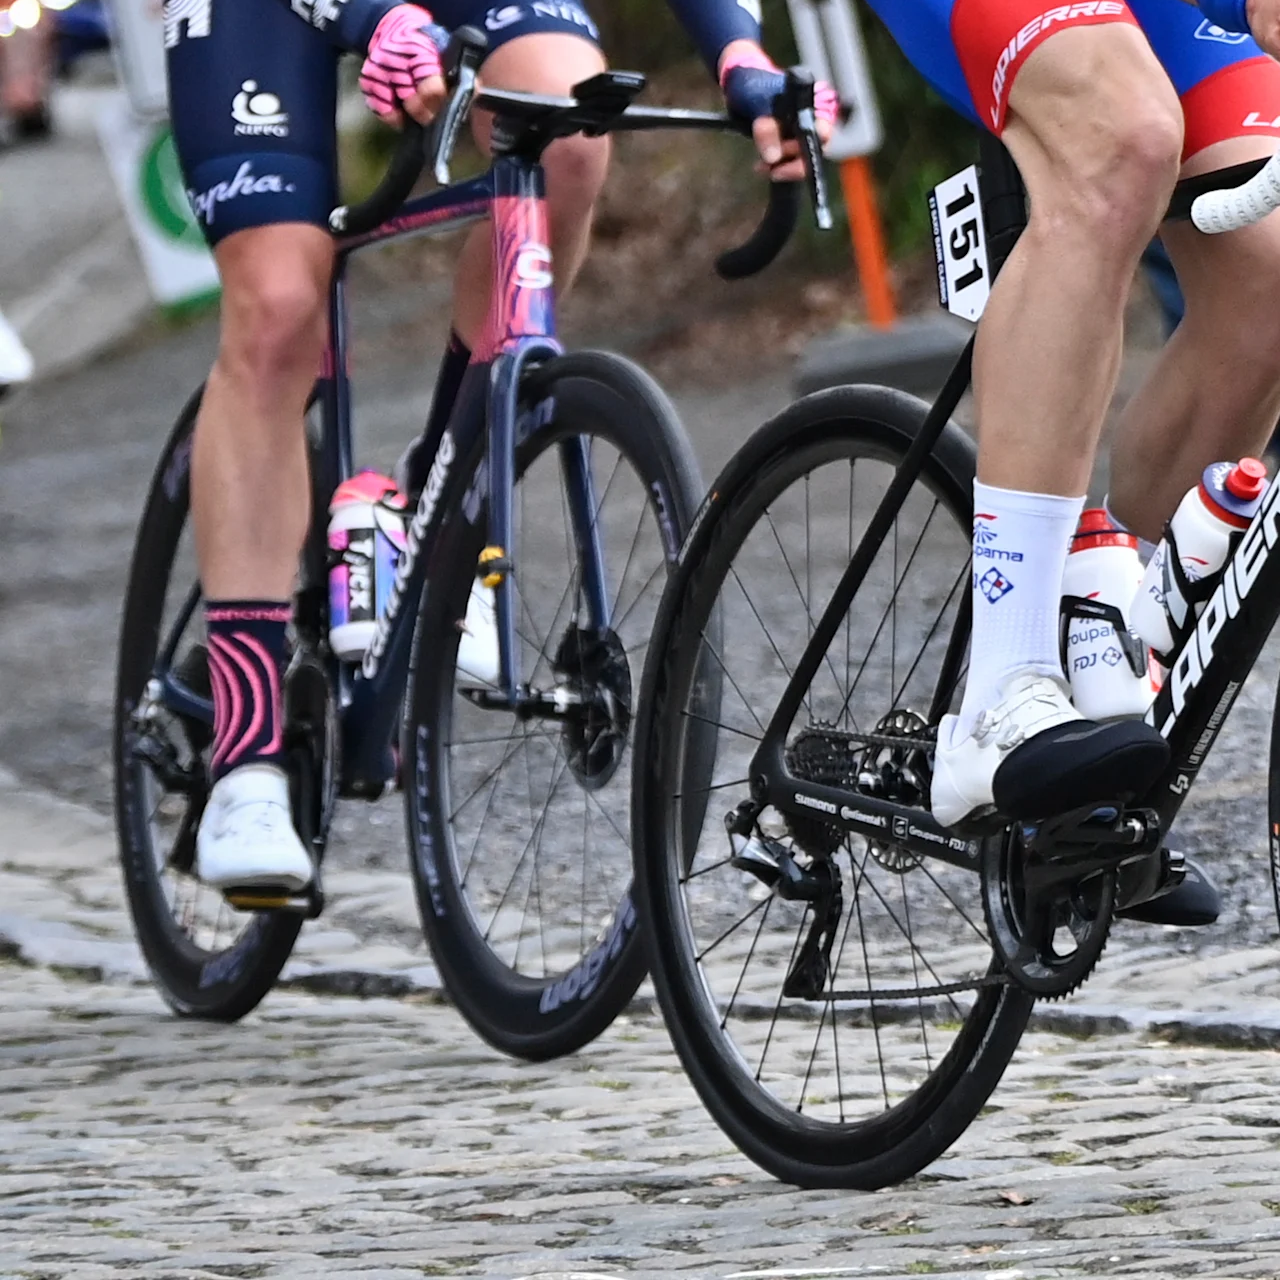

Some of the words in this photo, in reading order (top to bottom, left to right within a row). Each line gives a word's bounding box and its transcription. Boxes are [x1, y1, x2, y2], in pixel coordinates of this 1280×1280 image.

[990, 0, 1124, 129] LAPIERRE
[233, 124, 290, 138] NIPPO
[931, 209, 940, 236] SAXO
[935, 236, 944, 263] BANK
[945, 182, 984, 294] 151
[938, 264, 947, 304] CLASSIC
[362, 431, 456, 681] cannondale
[1073, 652, 1098, 673] FDJ
[840, 804, 882, 827] Continental
[908, 824, 944, 845] Groupama
[948, 833, 967, 852] FDJ
